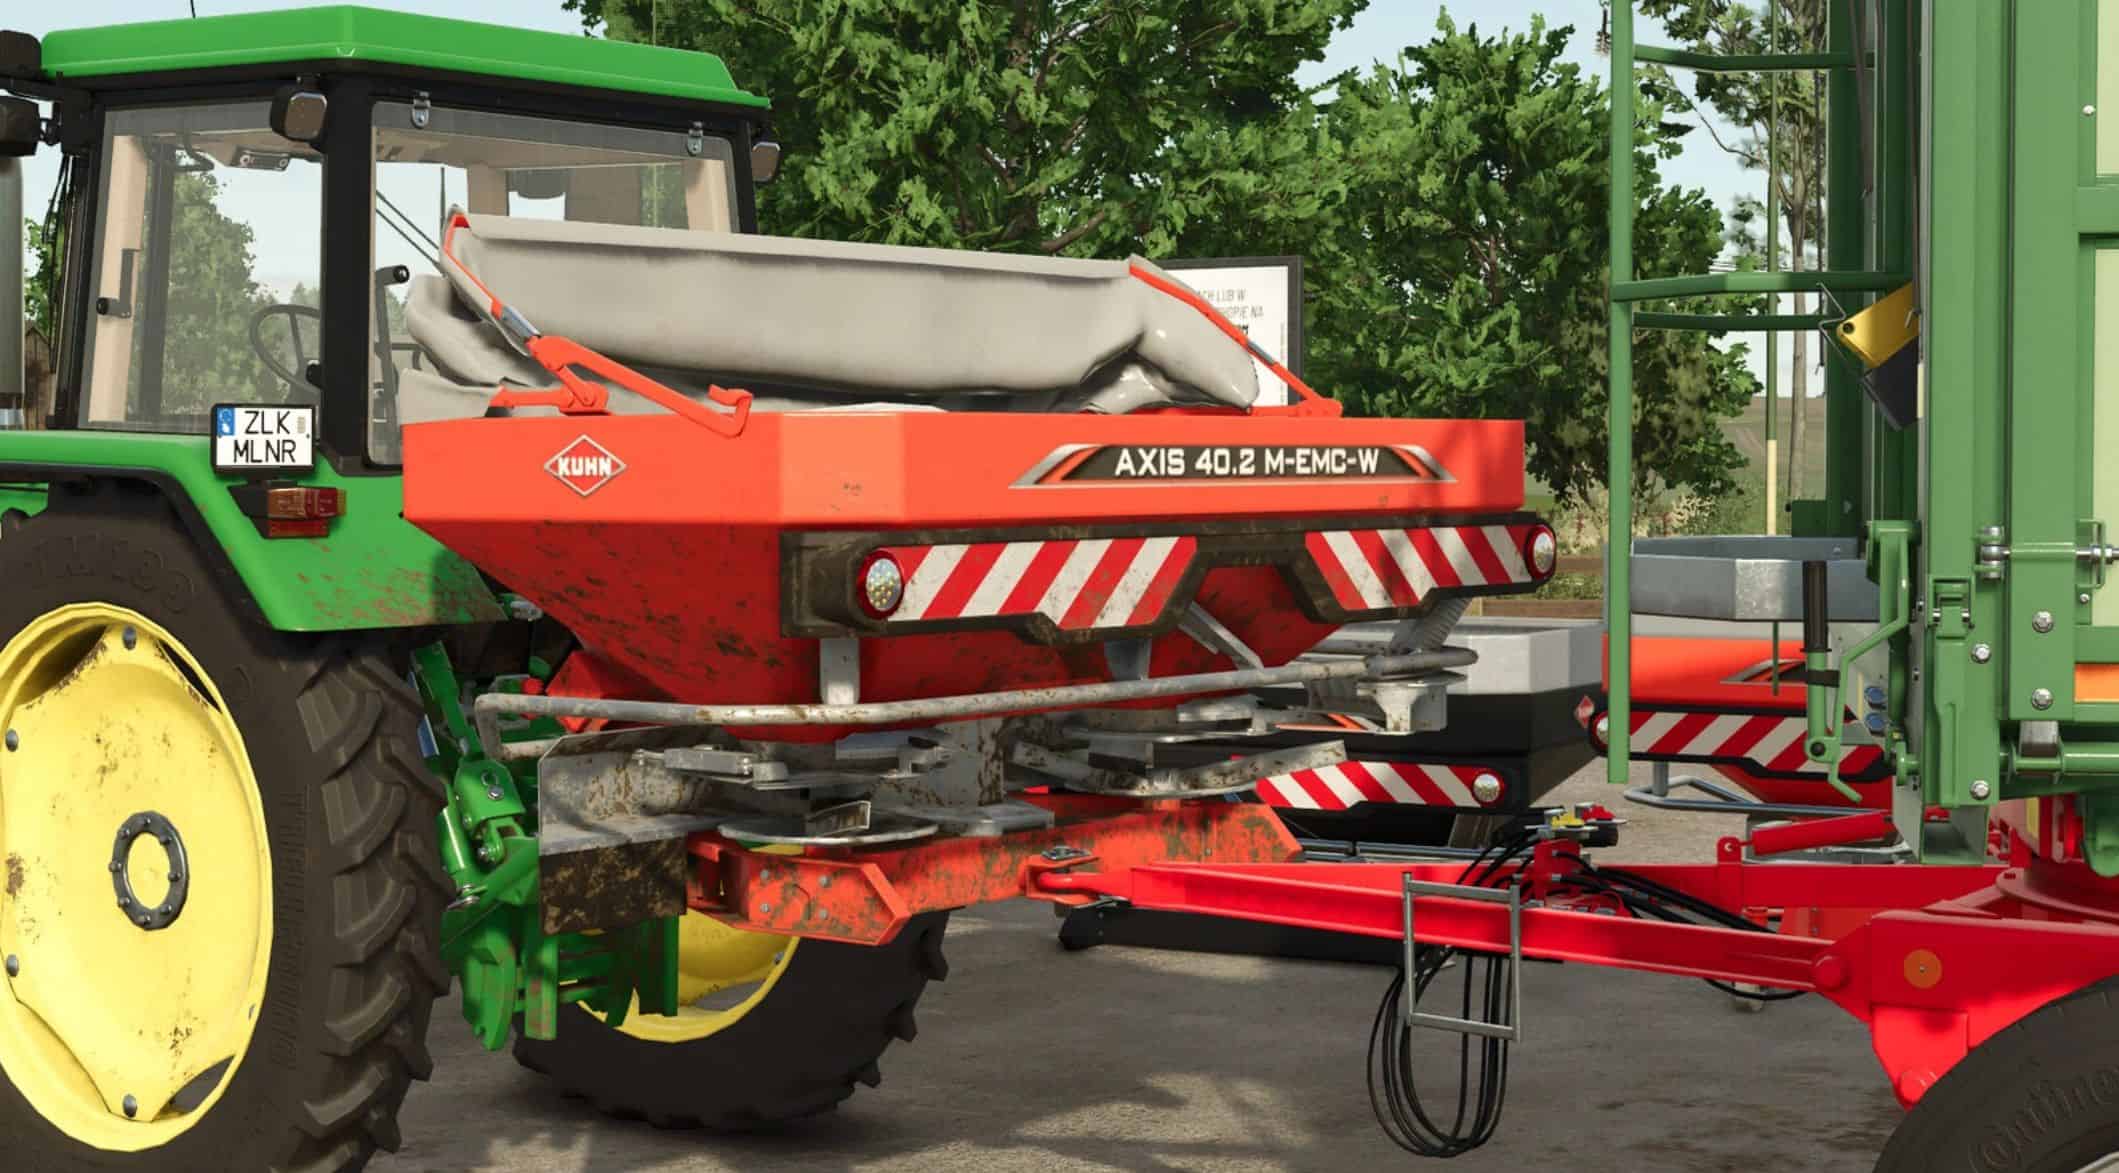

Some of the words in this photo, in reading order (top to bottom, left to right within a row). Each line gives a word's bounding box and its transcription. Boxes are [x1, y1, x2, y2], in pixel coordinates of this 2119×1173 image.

[244, 410, 291, 434] ZLK
[233, 439, 297, 463] MLNR
[1114, 448, 1185, 476] AXIS
[1195, 448, 1256, 476] 40.2
[1264, 448, 1380, 476] M-EMC-W
[558, 455, 612, 477] KUHN
